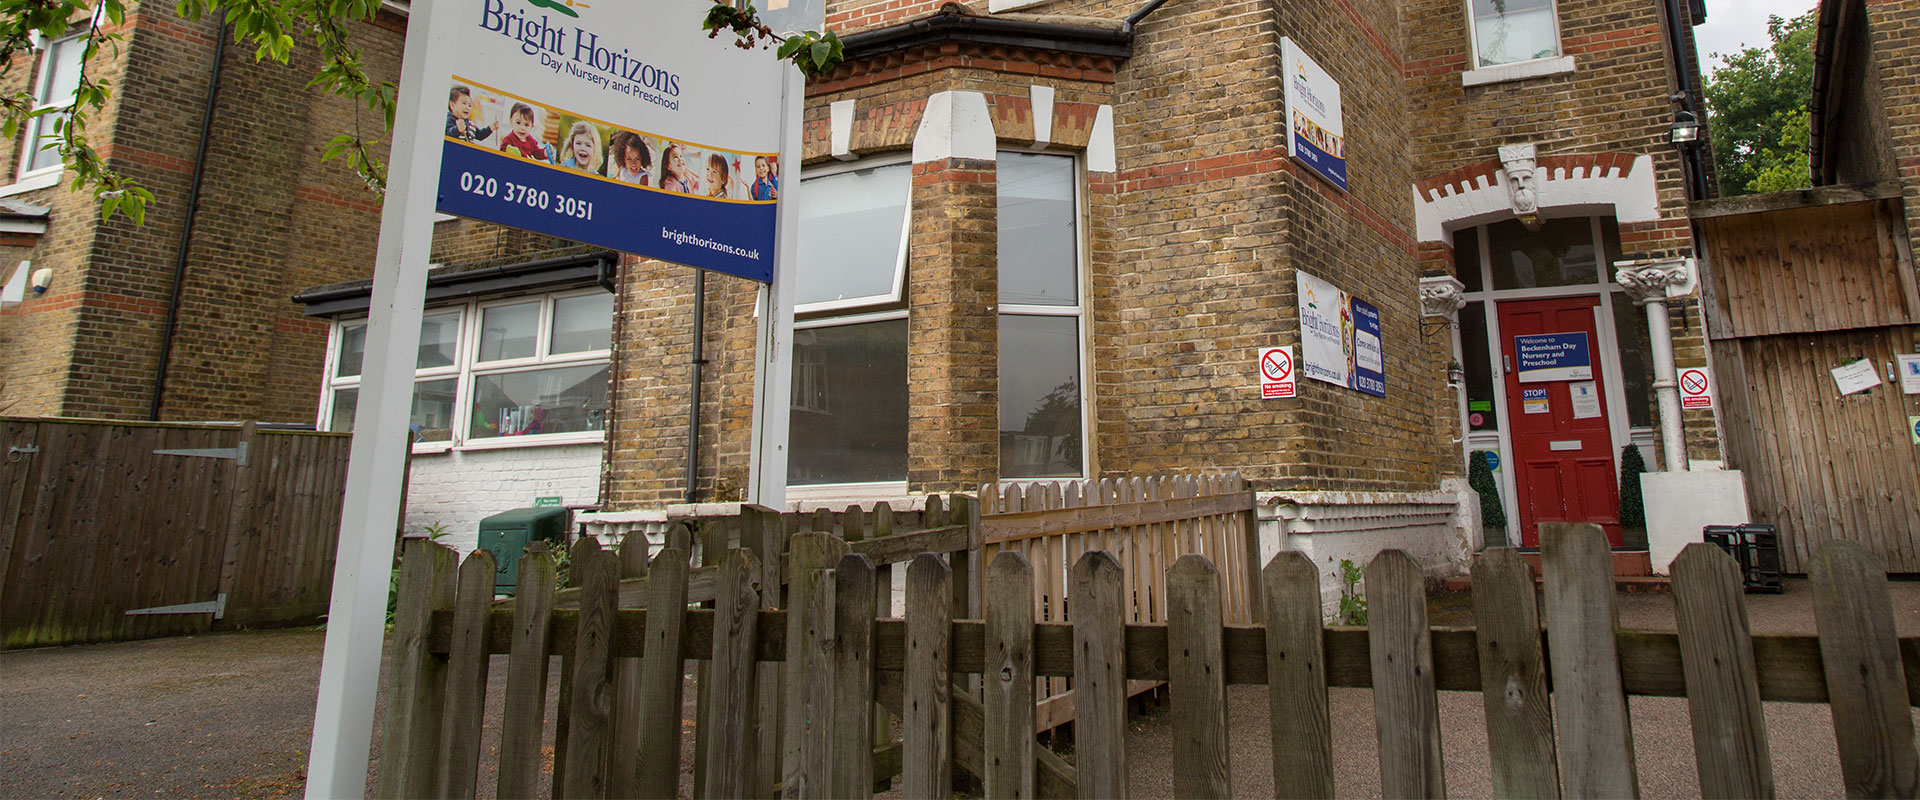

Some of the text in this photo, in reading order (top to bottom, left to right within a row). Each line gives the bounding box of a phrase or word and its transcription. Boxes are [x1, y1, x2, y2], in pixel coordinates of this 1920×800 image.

[478, 0, 680, 97] Bright Horizons
[540, 53, 679, 111] Day Nursery and Preschool
[460, 171, 593, 220] 020 3780 3051
[662, 227, 760, 260] brighthorizons.co.uk
[1521, 344, 1561, 352] Beckenham
[1524, 388, 1546, 397] STOP!
